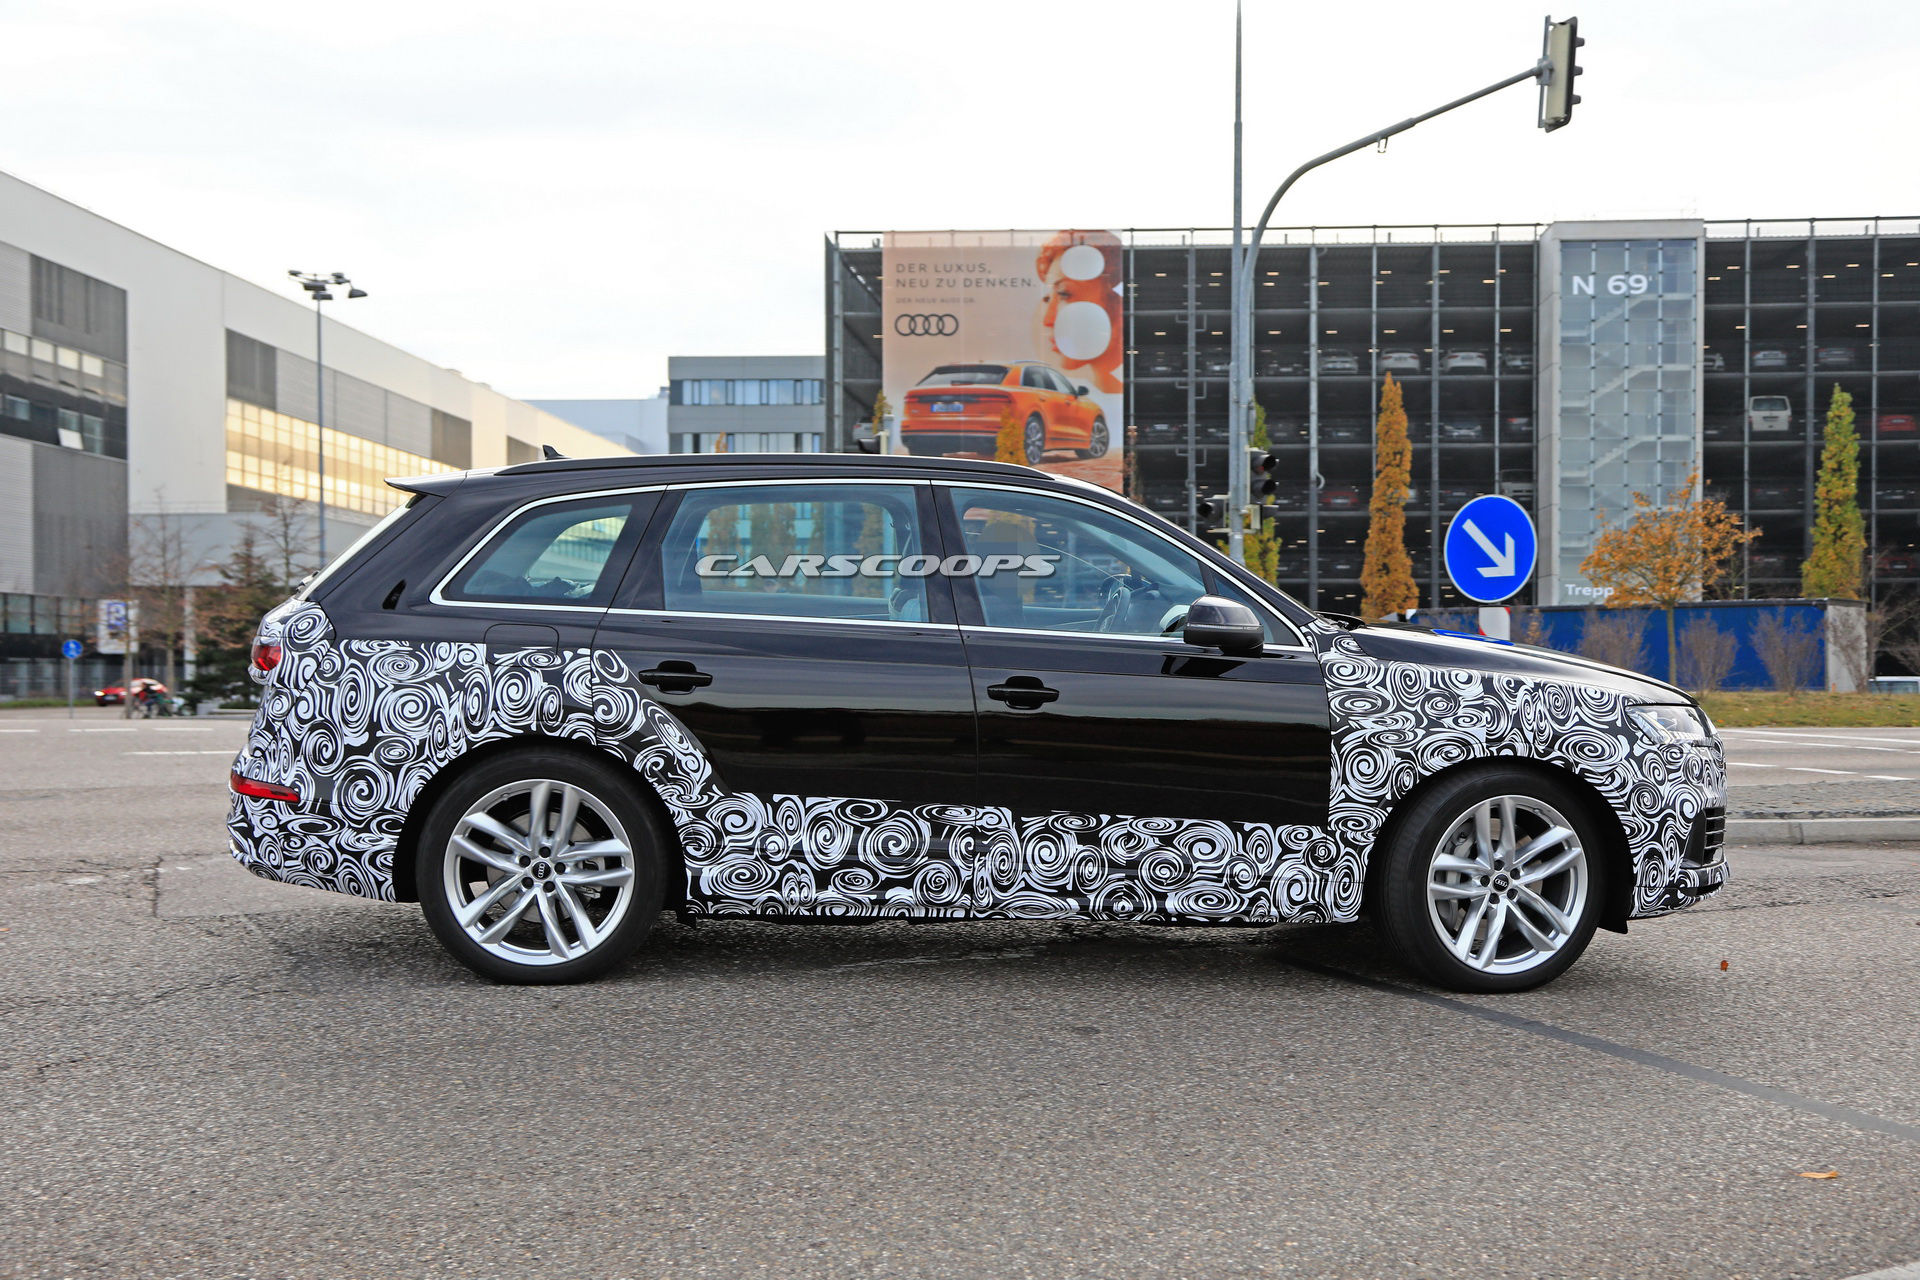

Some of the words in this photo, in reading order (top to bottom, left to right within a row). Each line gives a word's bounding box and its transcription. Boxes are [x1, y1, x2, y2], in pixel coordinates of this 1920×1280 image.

[896, 263, 927, 273] DER
[934, 262, 992, 274] LUXUS,
[896, 278, 929, 288] NEU
[935, 278, 957, 288] ZU
[963, 277, 1037, 288] DENKEN.
[1572, 275, 1595, 295] N
[1607, 274, 1648, 295] 69
